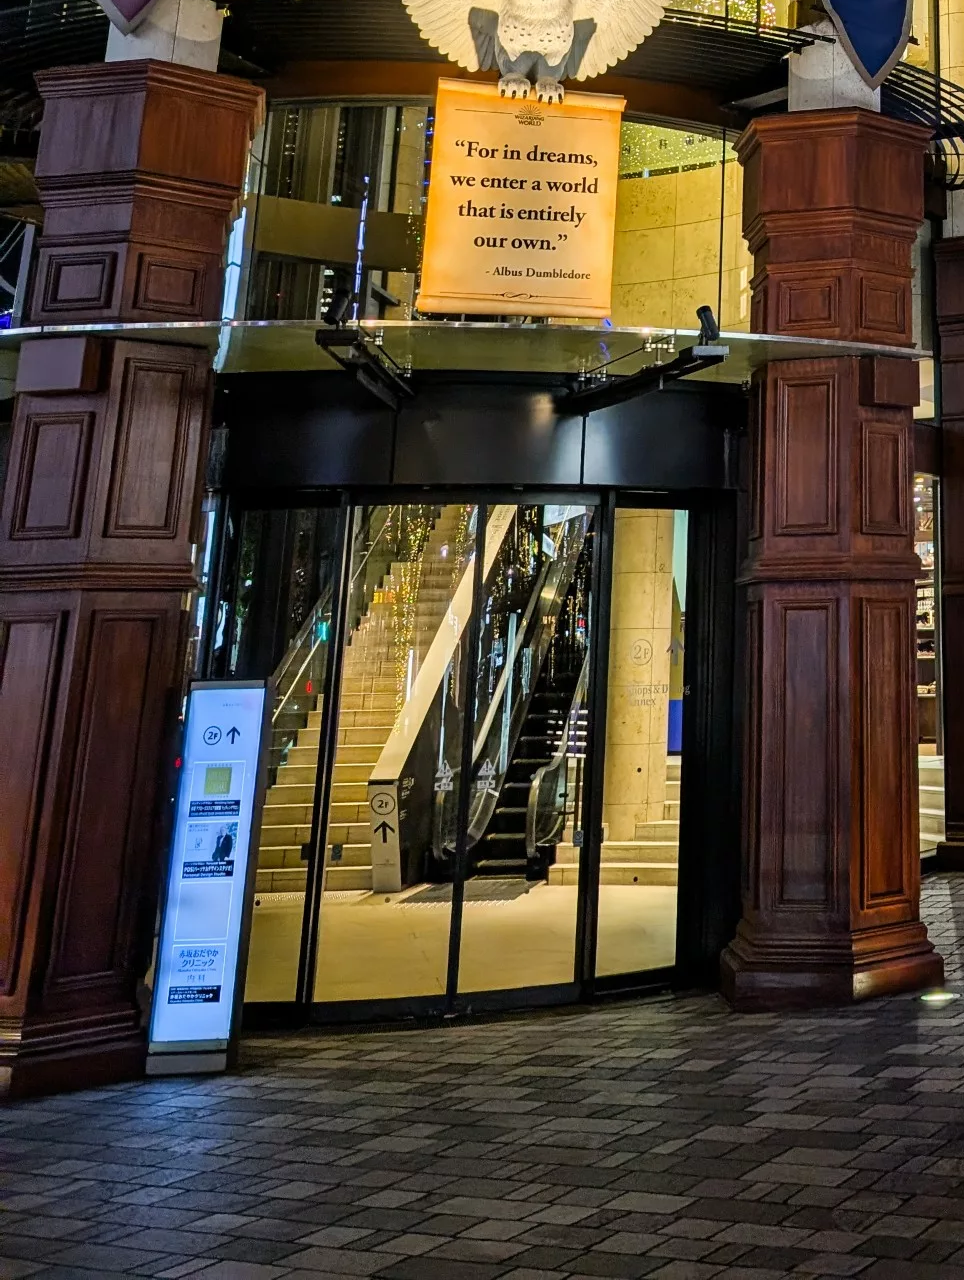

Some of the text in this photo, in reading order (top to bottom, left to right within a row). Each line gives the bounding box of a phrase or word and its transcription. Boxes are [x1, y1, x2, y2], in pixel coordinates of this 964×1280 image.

[503, 144, 521, 161] in
[527, 146, 598, 167] dreams,
[450, 175, 599, 194] we enter a world
[458, 200, 586, 228] that is entirely
[474, 236, 508, 248] our
[493, 266, 523, 278] Albus
[527, 268, 591, 280] Dumbledore
[634, 645, 650, 659] 2F
[207, 731, 218, 740] 2F
[377, 799, 389, 808] 2F
[179, 949, 219, 958] 赤坂おだやか
[182, 959, 215, 968] クリニック
